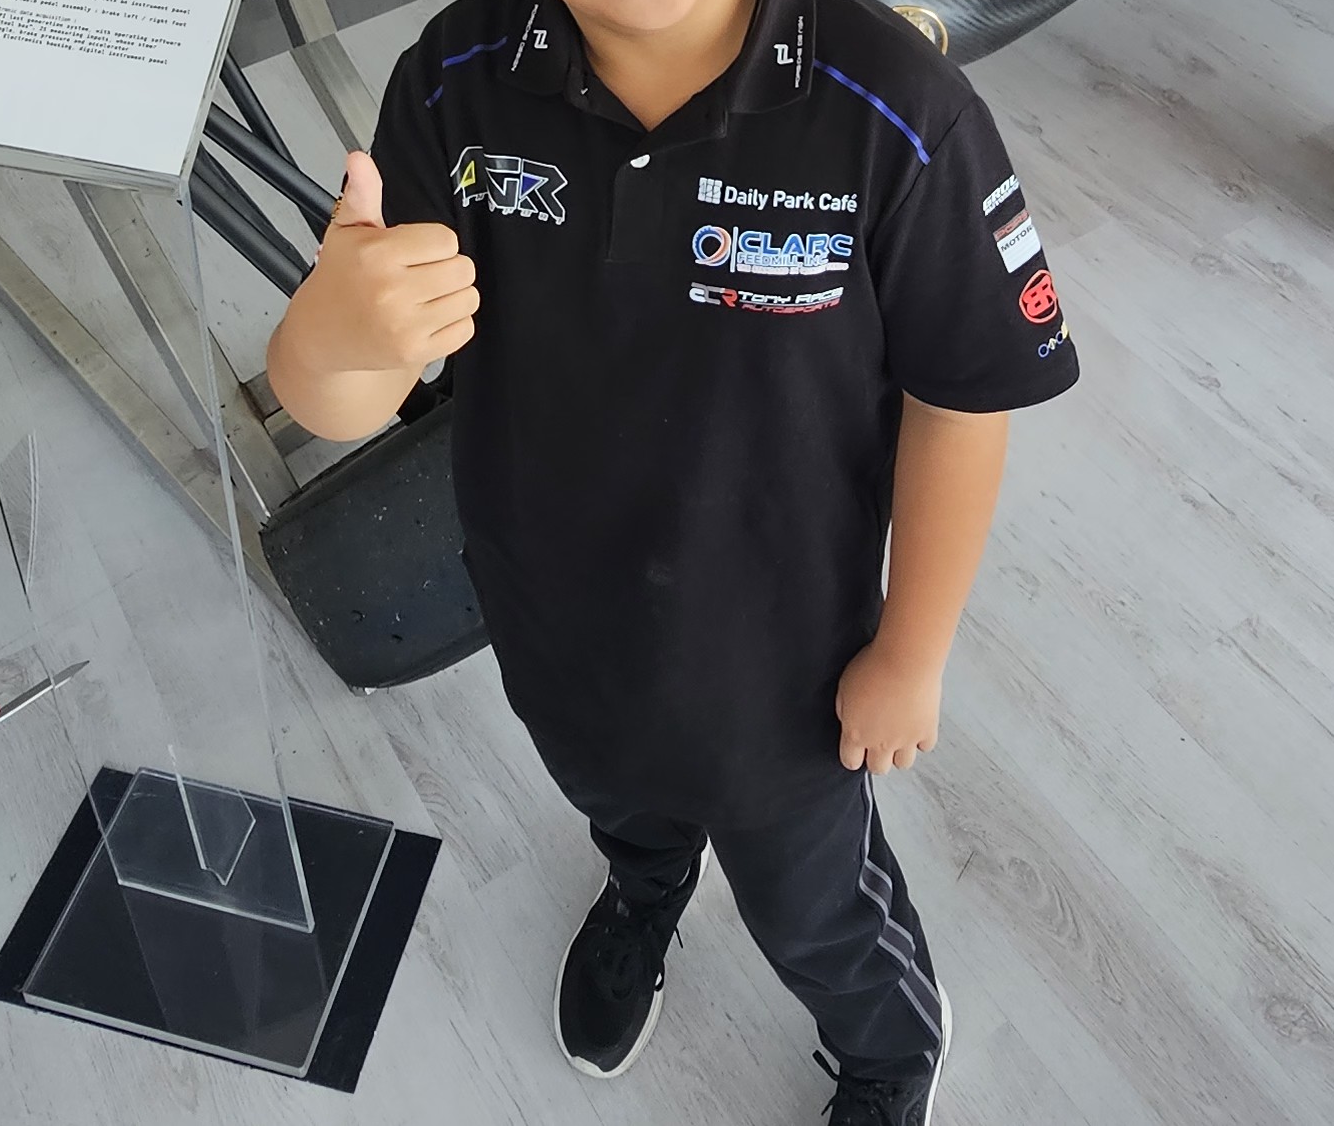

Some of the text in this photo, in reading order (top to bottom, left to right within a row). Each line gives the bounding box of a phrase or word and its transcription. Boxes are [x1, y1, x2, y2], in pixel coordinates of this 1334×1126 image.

[724, 186, 859, 213] Daily Park Café
[738, 230, 855, 257] CLARC
[737, 250, 803, 267] FEEDMILL
[738, 290, 791, 304] TONY
